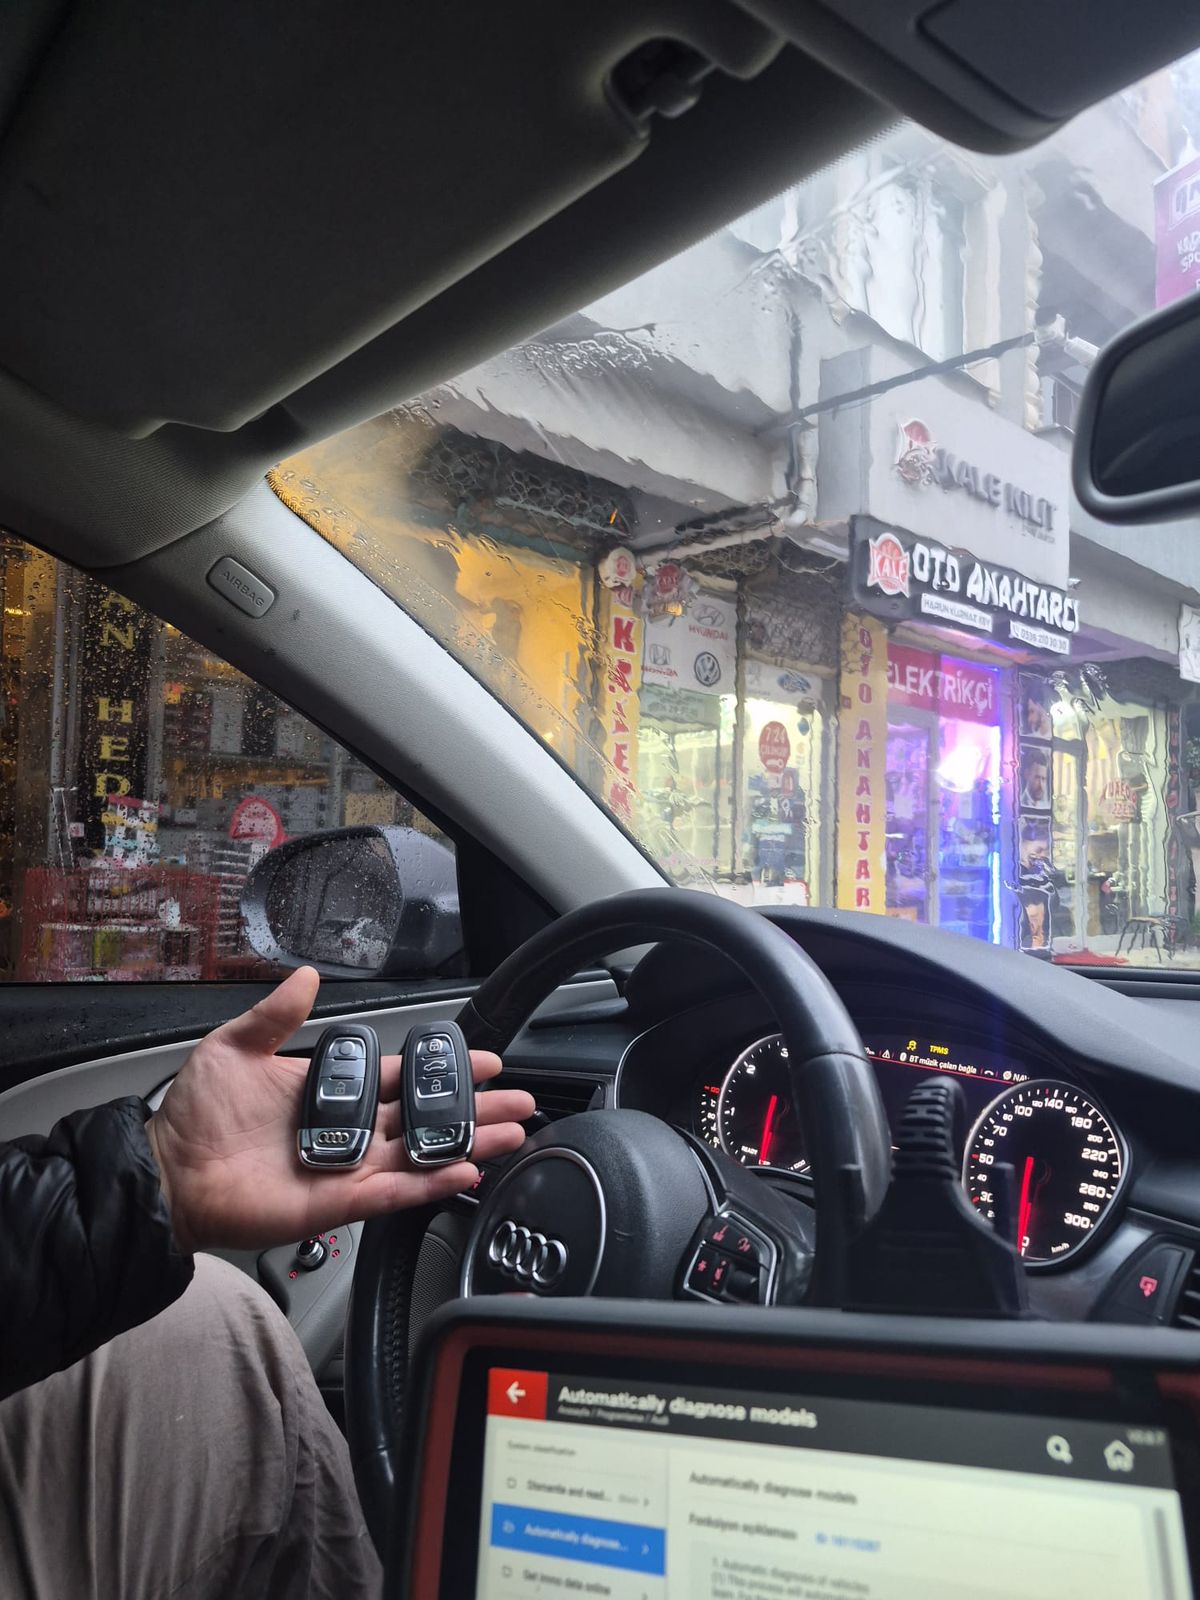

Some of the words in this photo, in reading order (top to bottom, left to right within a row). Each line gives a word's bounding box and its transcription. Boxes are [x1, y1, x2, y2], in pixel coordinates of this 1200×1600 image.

[221, 570, 266, 609] AIRBAG
[912, 543, 960, 592] OTO
[966, 562, 1080, 633] ANAHTARCI
[688, 624, 729, 641] HYUNDAI
[855, 719, 873, 908] ANAHTAR
[780, 1047, 789, 1058] 3
[929, 1044, 949, 1055] TPMS
[746, 1064, 756, 1075] 2
[909, 1055, 918, 1063] BT
[919, 1056, 939, 1067] müzik
[939, 1059, 957, 1071] çalan
[958, 1063, 977, 1074] bağla
[1014, 1104, 1033, 1117] 100
[1044, 1097, 1064, 1110] 140
[730, 1106, 736, 1116] 1
[1071, 1116, 1093, 1130] 180
[992, 1124, 1007, 1137] 70
[1087, 1134, 1103, 1144] 200
[978, 1154, 994, 1165] 50
[1081, 1148, 1108, 1163] 220
[977, 1174, 987, 1182] 40
[1092, 1169, 1109, 1180] 240
[1079, 1183, 1106, 1198] 260
[1063, 1212, 1091, 1229] 300
[558, 1386, 667, 1414] Automatically
[669, 1396, 747, 1420] diagnose
[750, 1405, 818, 1428] models
[689, 1471, 760, 1492] Automatically
[764, 1481, 813, 1498] diagnose
[524, 1522, 580, 1545] Automatically
